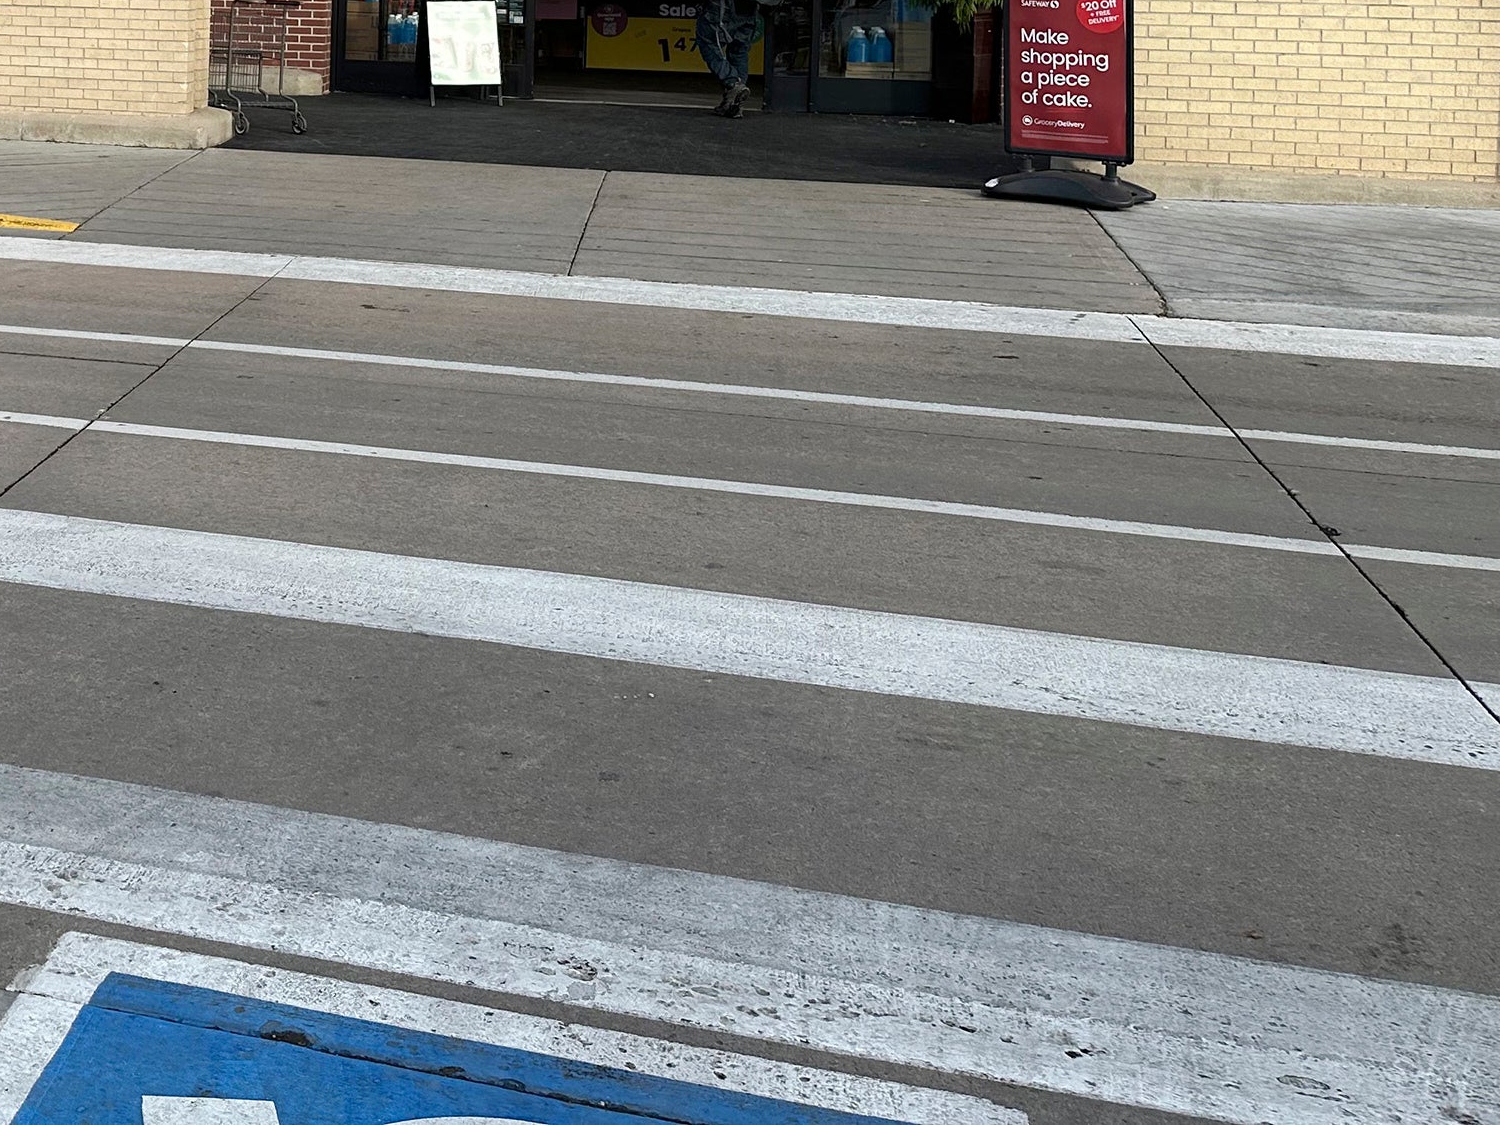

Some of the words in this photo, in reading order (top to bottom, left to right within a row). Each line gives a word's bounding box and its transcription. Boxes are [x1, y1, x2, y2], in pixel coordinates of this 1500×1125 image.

[1021, 0, 1049, 8] SAFEWAY
[1081, 1, 1099, 13] $20
[1021, 28, 1069, 45] Make
[1021, 48, 1109, 72] shopping
[1021, 71, 1033, 84] a
[1038, 70, 1090, 89] piece
[1022, 89, 1038, 104] of
[1043, 92, 1092, 108] cake.
